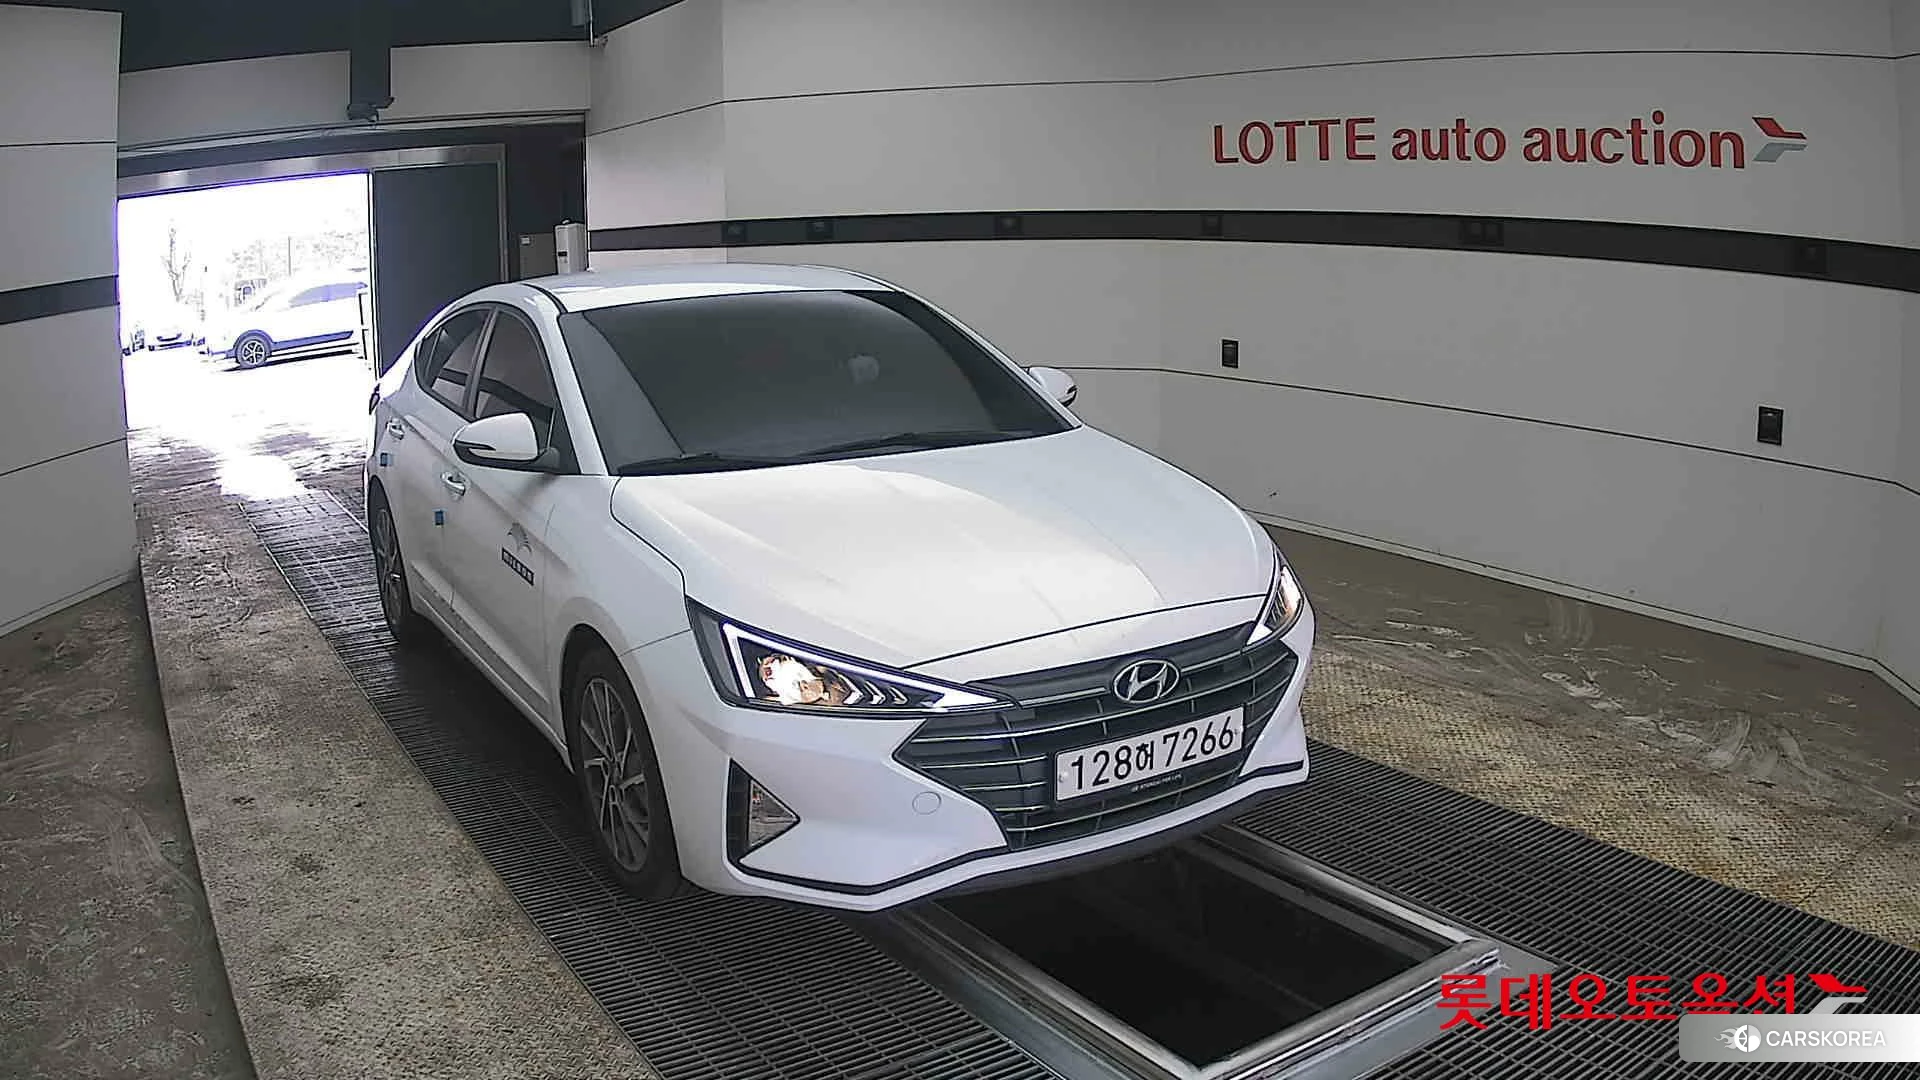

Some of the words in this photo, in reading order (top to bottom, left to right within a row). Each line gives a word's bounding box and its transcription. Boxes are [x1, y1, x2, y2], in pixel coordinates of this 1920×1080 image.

[1213, 117, 1376, 164] LOTTE
[1391, 117, 1506, 163] auto
[1523, 110, 1746, 169] auction
[1070, 740, 1155, 791] 128허
[1162, 716, 1234, 768] 7266
